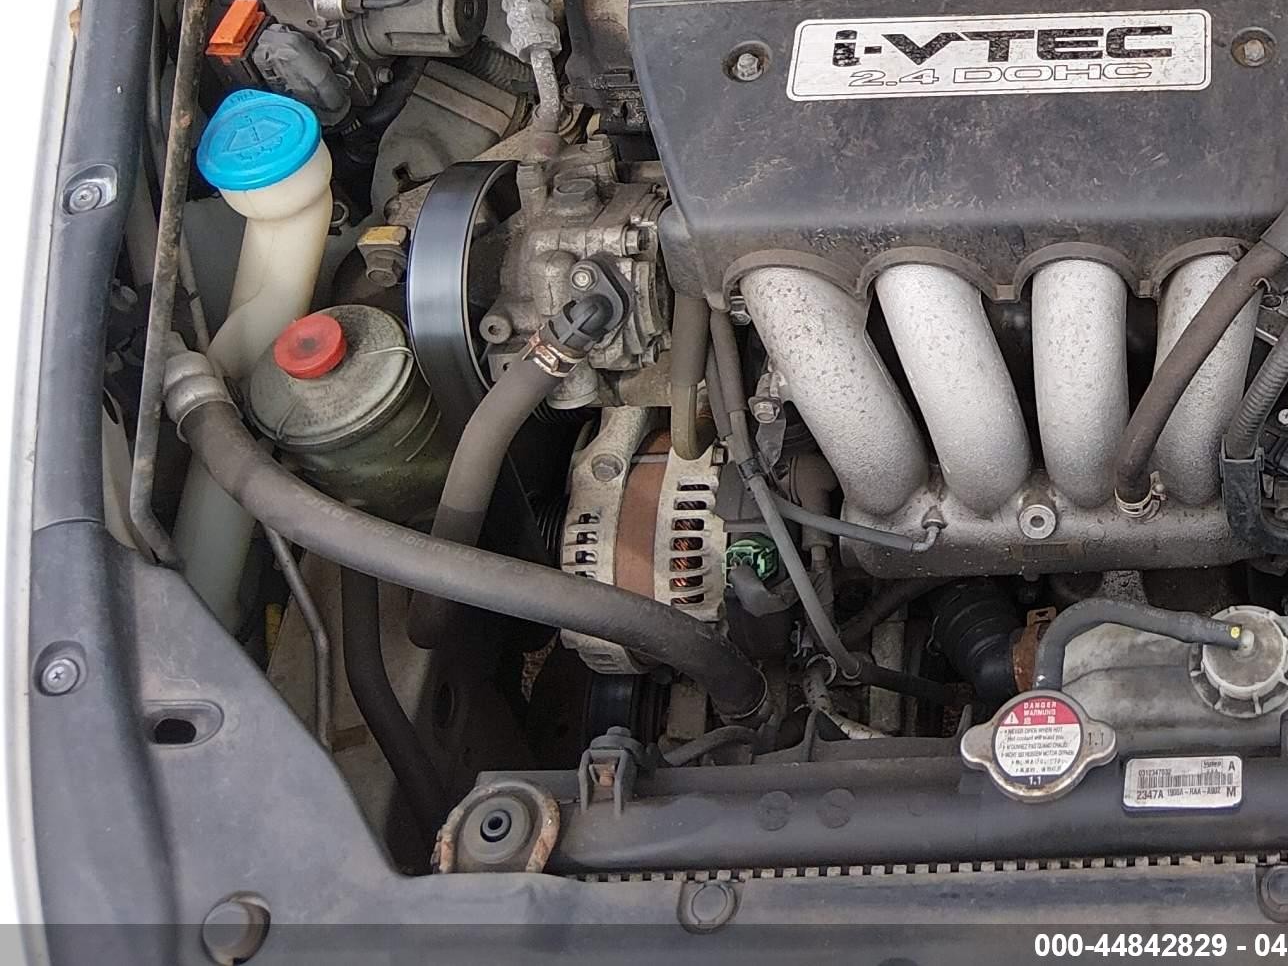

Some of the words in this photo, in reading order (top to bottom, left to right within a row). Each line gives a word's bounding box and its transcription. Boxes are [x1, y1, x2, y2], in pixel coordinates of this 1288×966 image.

[832, 24, 1173, 68] i-VTEC
[848, 68, 940, 87] 2.4
[952, 62, 1153, 84] DOHC
[1023, 701, 1057, 709] DANGER
[1087, 732, 1104, 746] 1.1
[1228, 761, 1236, 771] A
[1028, 776, 1042, 786] 1.1
[1136, 789, 1164, 800] 2347A
[1226, 787, 1237, 798] M
